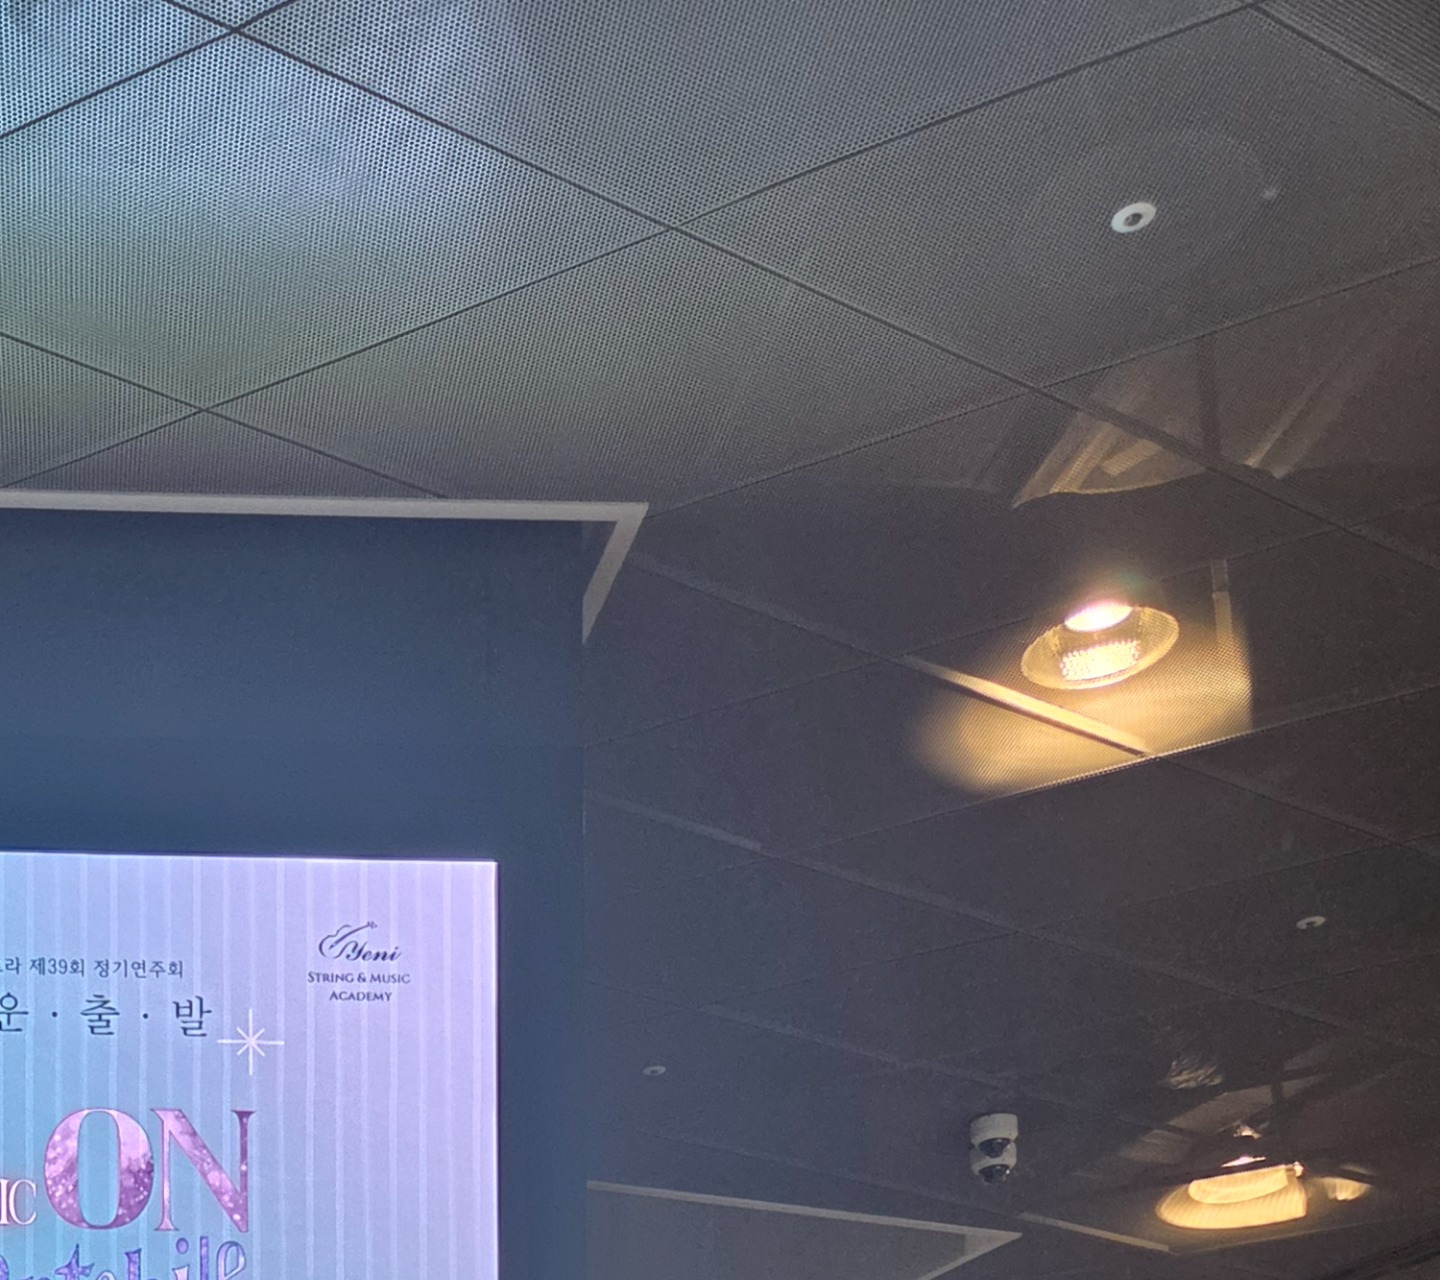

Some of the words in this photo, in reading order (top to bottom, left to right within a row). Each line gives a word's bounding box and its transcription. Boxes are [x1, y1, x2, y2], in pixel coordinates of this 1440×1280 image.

[334, 940, 401, 961] Yeni
[29, 957, 85, 977] 제39회
[94, 959, 183, 978] 정기연주회
[308, 971, 354, 983] STRING
[357, 972, 366, 983] &
[370, 973, 411, 984] MUSIC
[329, 990, 392, 1001] ACADEMY
[44, 1107, 257, 1232] ON
